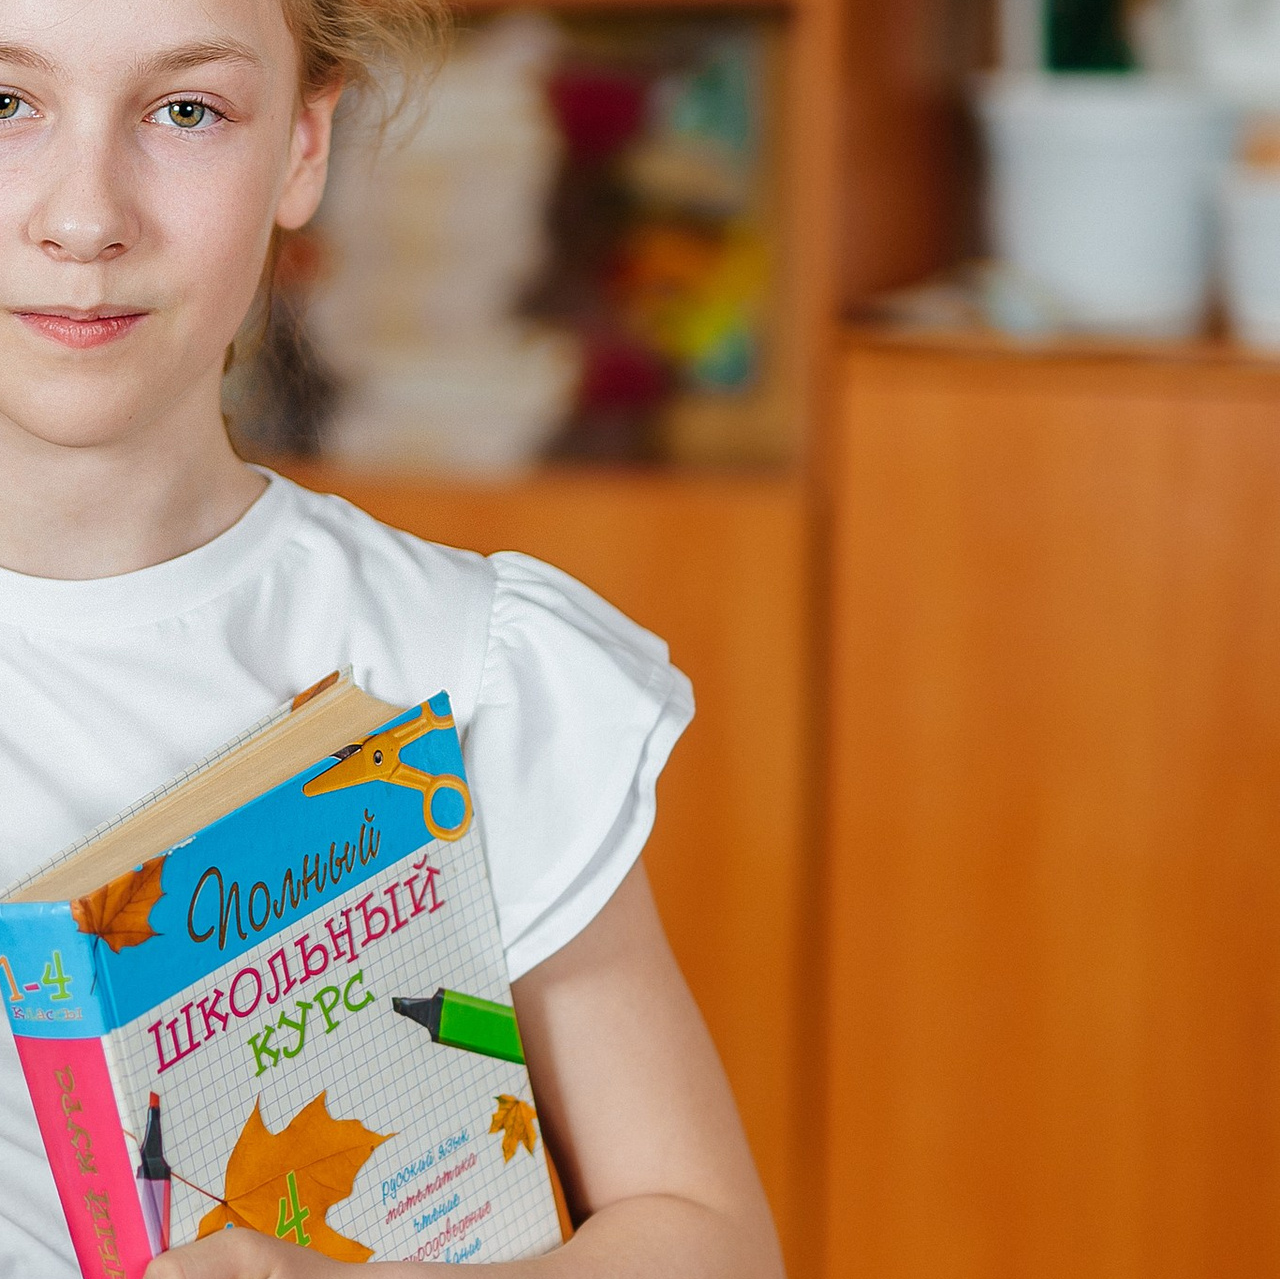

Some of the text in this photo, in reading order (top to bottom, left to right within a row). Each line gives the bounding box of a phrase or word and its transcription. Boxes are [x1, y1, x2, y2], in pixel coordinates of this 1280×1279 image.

[187, 808, 381, 951] Полный
[147, 853, 446, 1074] ШКОЛЬНЫЙ
[247, 969, 375, 1077] КУРС
[382, 1128, 469, 1205] русский язык
[386, 1152, 477, 1224] математика
[414, 1193, 460, 1233] чтение
